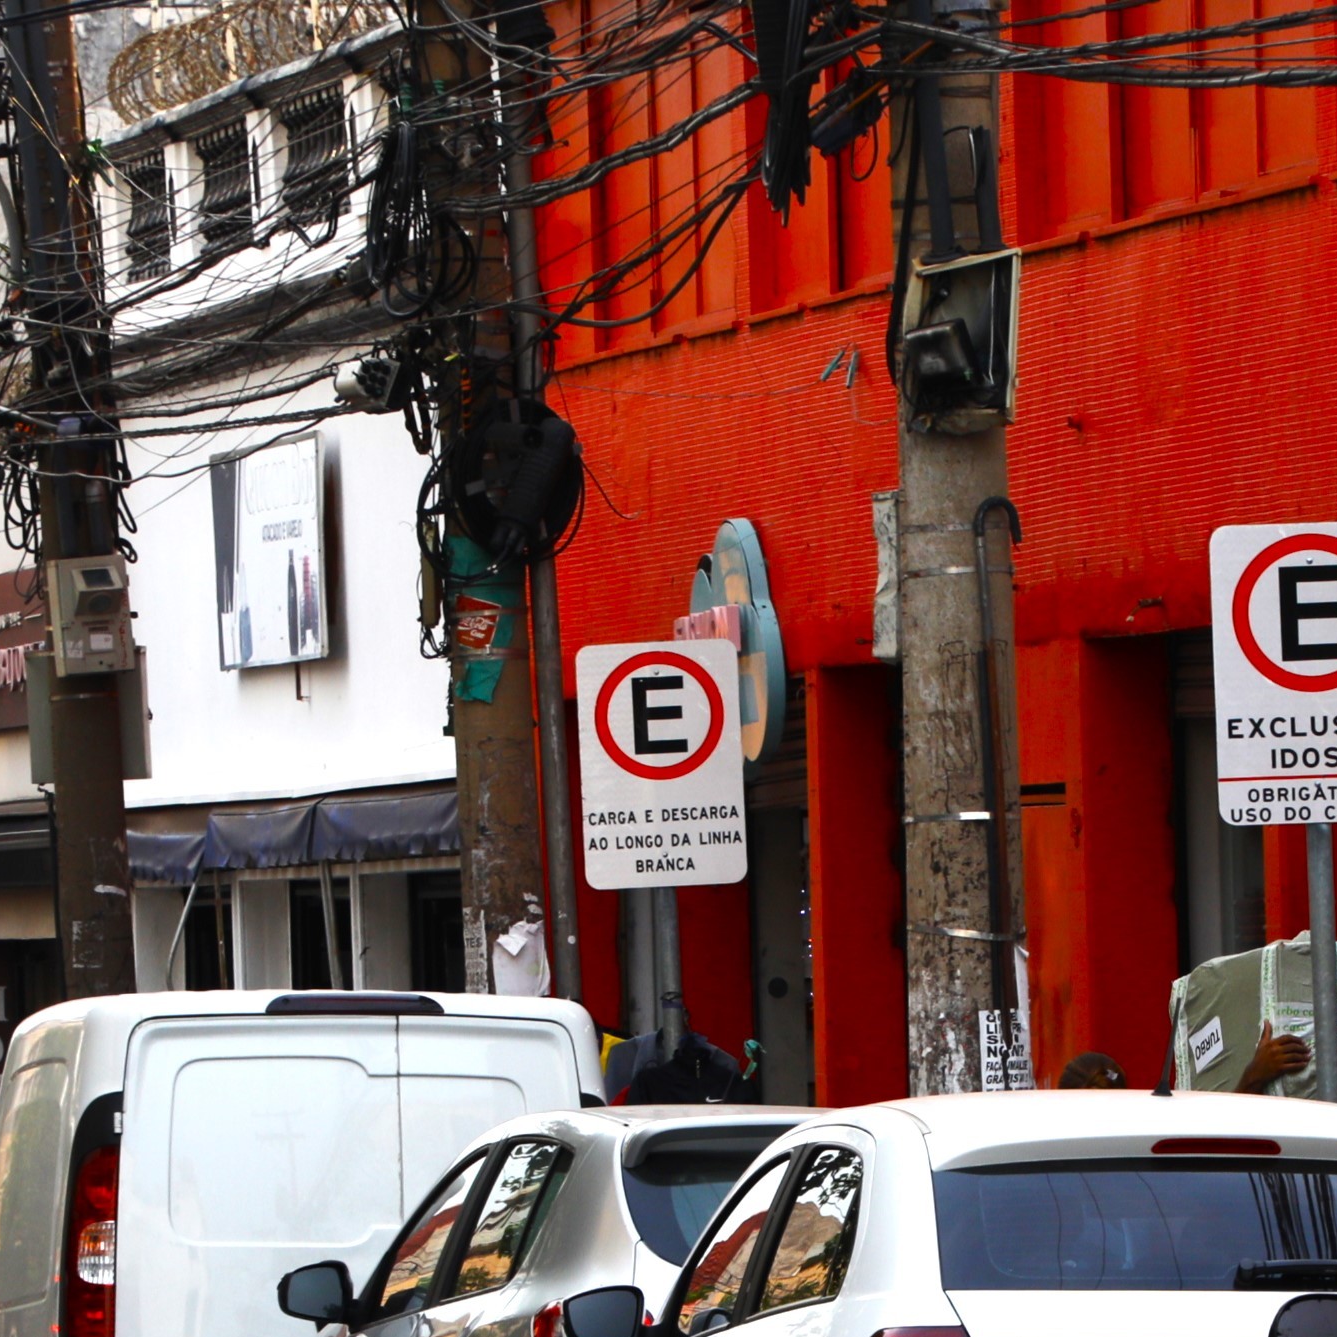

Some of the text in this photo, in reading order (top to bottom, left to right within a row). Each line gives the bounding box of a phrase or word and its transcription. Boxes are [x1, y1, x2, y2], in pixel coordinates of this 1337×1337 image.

[631, 675, 689, 755] E
[588, 806, 739, 826] CARGA E DESCARGA
[1230, 808, 1272, 823] USO
[1284, 807, 1311, 821] DO
[588, 830, 743, 851] AO LONGO DA LINHA
[636, 857, 695, 873] BRANCA
[1194, 1027, 1221, 1061] TURBO
